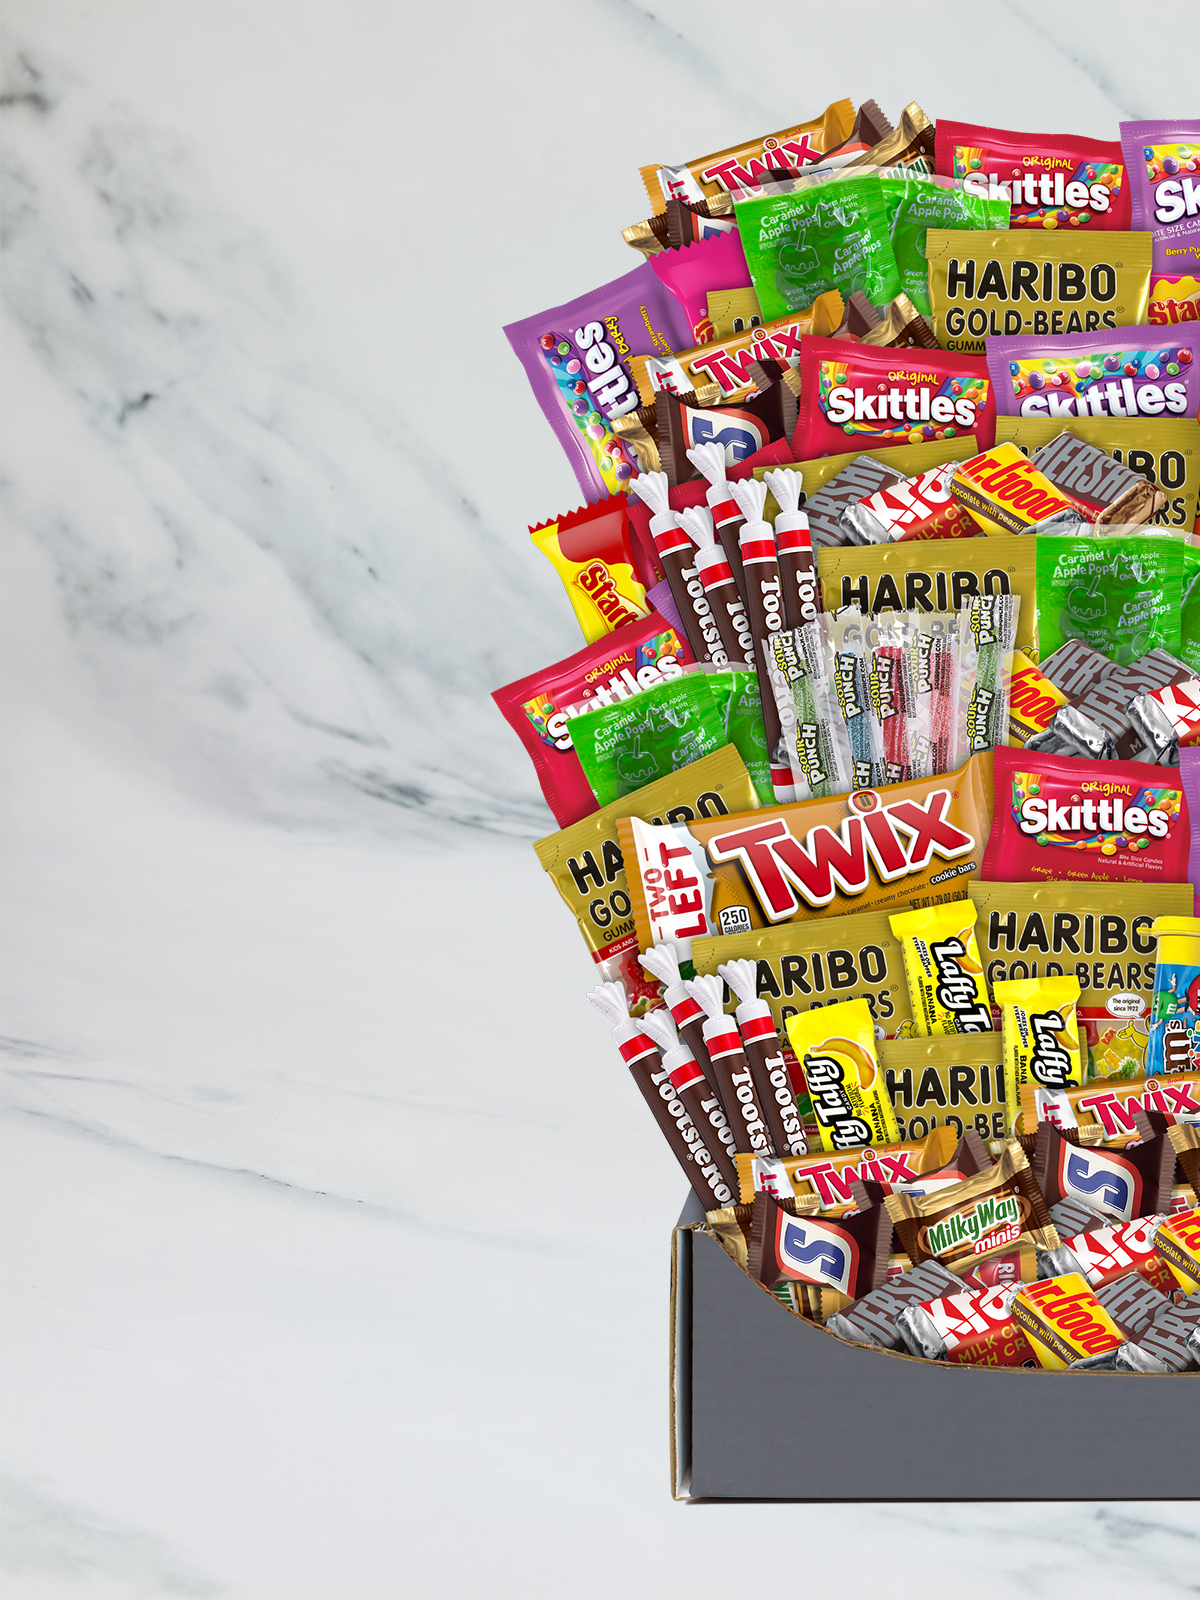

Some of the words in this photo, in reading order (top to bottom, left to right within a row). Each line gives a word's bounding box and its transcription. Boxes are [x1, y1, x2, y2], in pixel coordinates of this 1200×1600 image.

[962, 172, 1110, 212] Skittles
[758, 222, 792, 242] Apple
[792, 215, 818, 233] Pops
[760, 204, 806, 228] Caramel
[1164, 223, 1186, 235] SIZE
[834, 230, 872, 259] Caramel
[1166, 247, 1188, 256] Berry
[784, 287, 806, 298] Green
[806, 279, 826, 291] Apple
[946, 259, 1117, 302] HARIBO
[946, 307, 1116, 336] GOLD-BEARS
[826, 387, 976, 426] Skittles
[1021, 378, 1188, 418] Skittles
[1052, 564, 1086, 578] Apple
[1088, 563, 1115, 577] Pops
[1058, 552, 1104, 566] Caramel
[1122, 592, 1164, 615] Caramel
[835, 670, 847, 712] SOUR
[840, 655, 860, 718] PUNCH
[876, 656, 896, 720] PUNCH
[974, 690, 996, 750] PUNCH
[796, 739, 810, 773] SOUR
[801, 722, 827, 786] PUNCH
[1019, 798, 1169, 837] Skittles
[659, 842, 708, 938] LEFT
[930, 870, 957, 885] cookie
[958, 862, 976, 875] bars
[644, 868, 670, 922] TWO
[846, 902, 870, 916] caramel
[874, 894, 896, 906] creamy
[896, 883, 926, 900] chocolate
[722, 908, 748, 925] 250
[988, 911, 1156, 954] HARIBO
[609, 943, 621, 954] KIDS
[621, 938, 634, 949] AND
[930, 938, 978, 1010] Laffy
[925, 984, 938, 1025] BANANA
[1121, 998, 1140, 1006] original
[1126, 1004, 1139, 1012] 1922
[1031, 1012, 1070, 1087] Laffy
[806, 1057, 844, 1126] Taffy
[870, 1102, 884, 1142] BANANA
[974, 1224, 1022, 1254] minis
